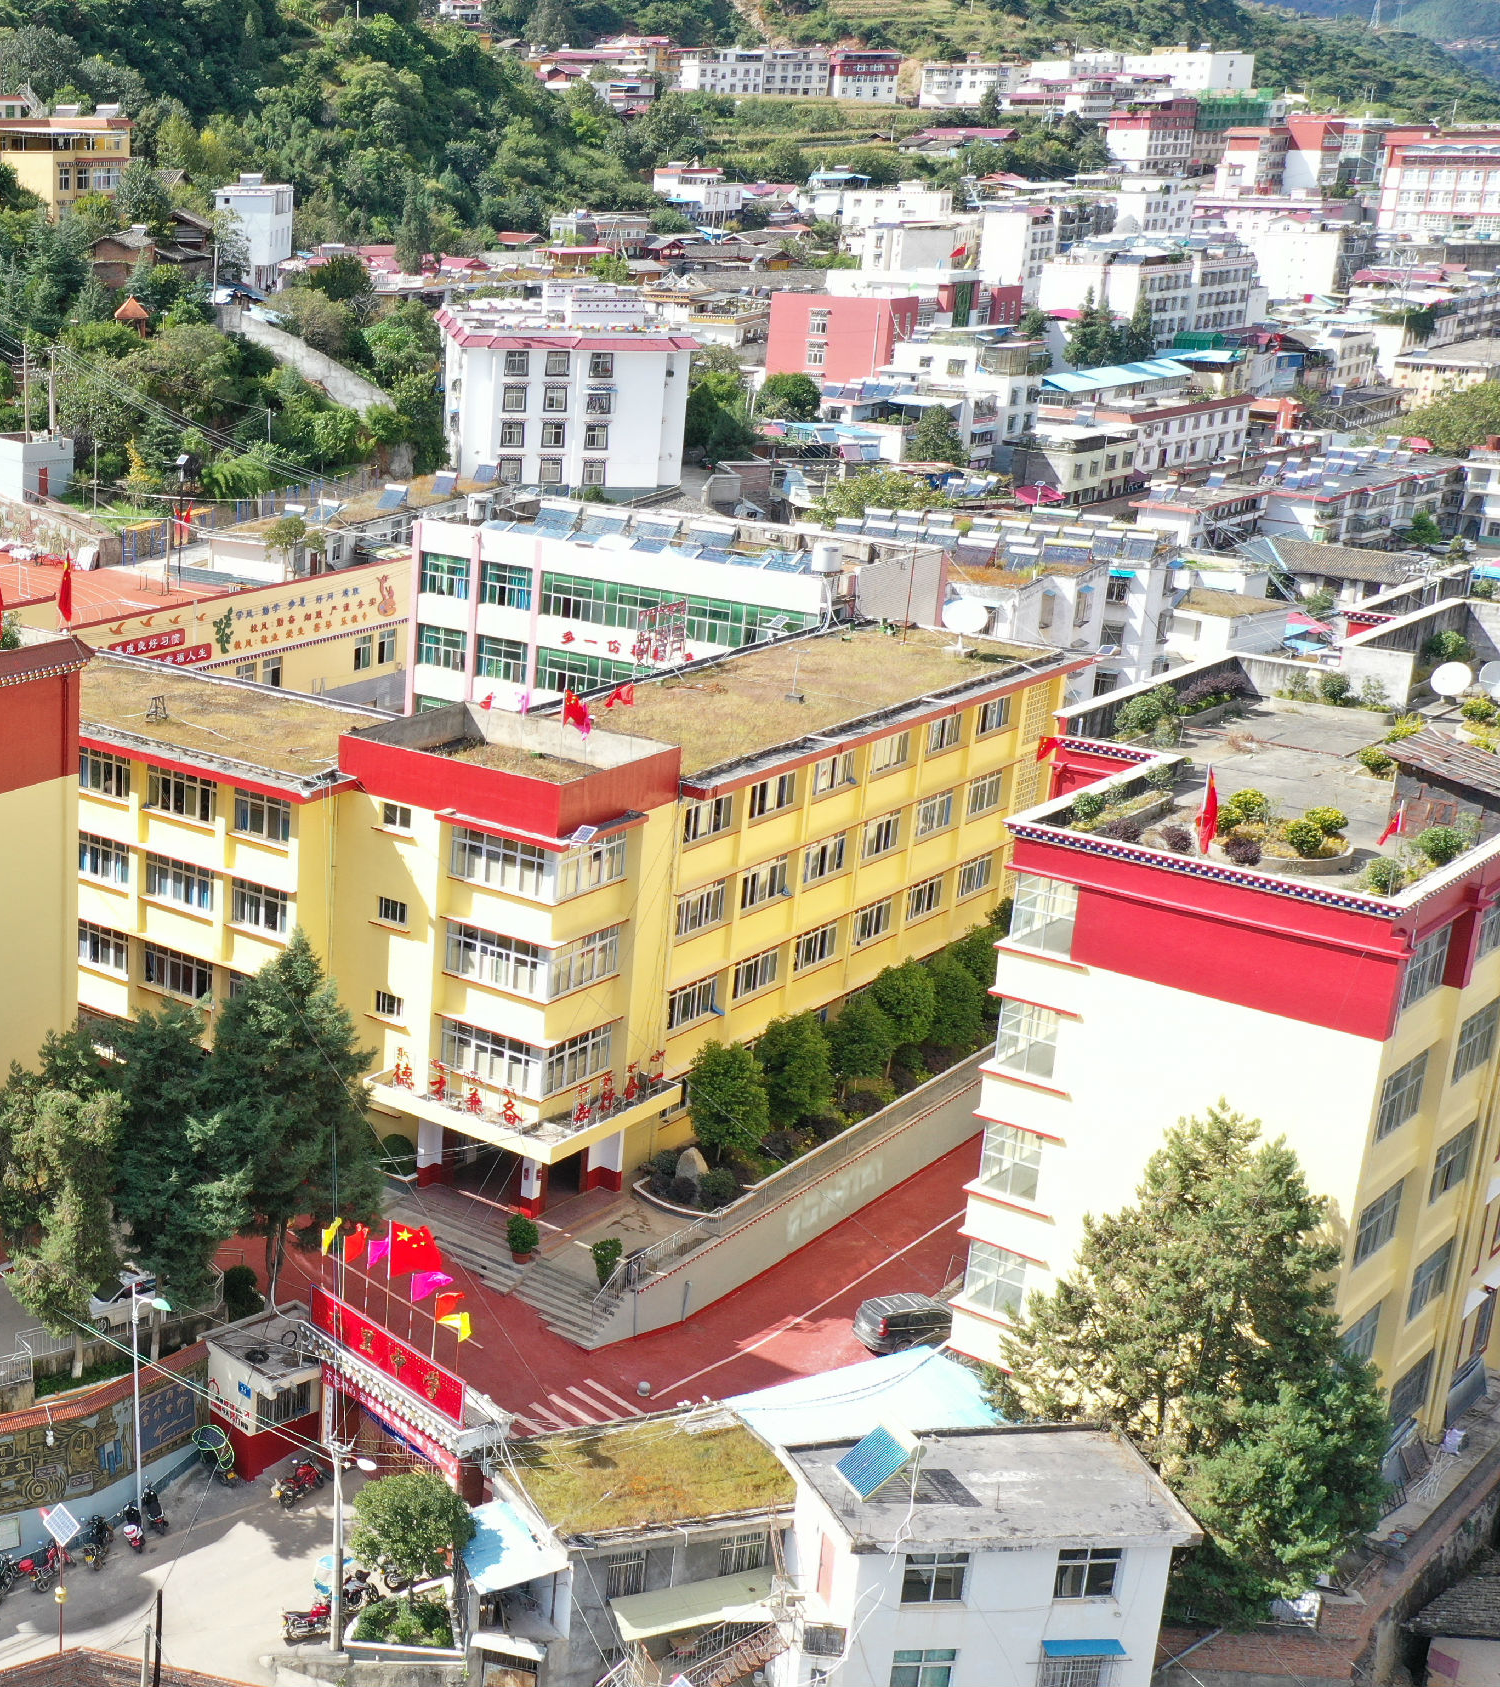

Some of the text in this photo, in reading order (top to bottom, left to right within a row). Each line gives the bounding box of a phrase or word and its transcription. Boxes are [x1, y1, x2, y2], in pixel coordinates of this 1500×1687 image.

[393, 1063, 524, 1126] 德才兼备
[573, 1071, 664, 1124] 知行合一
